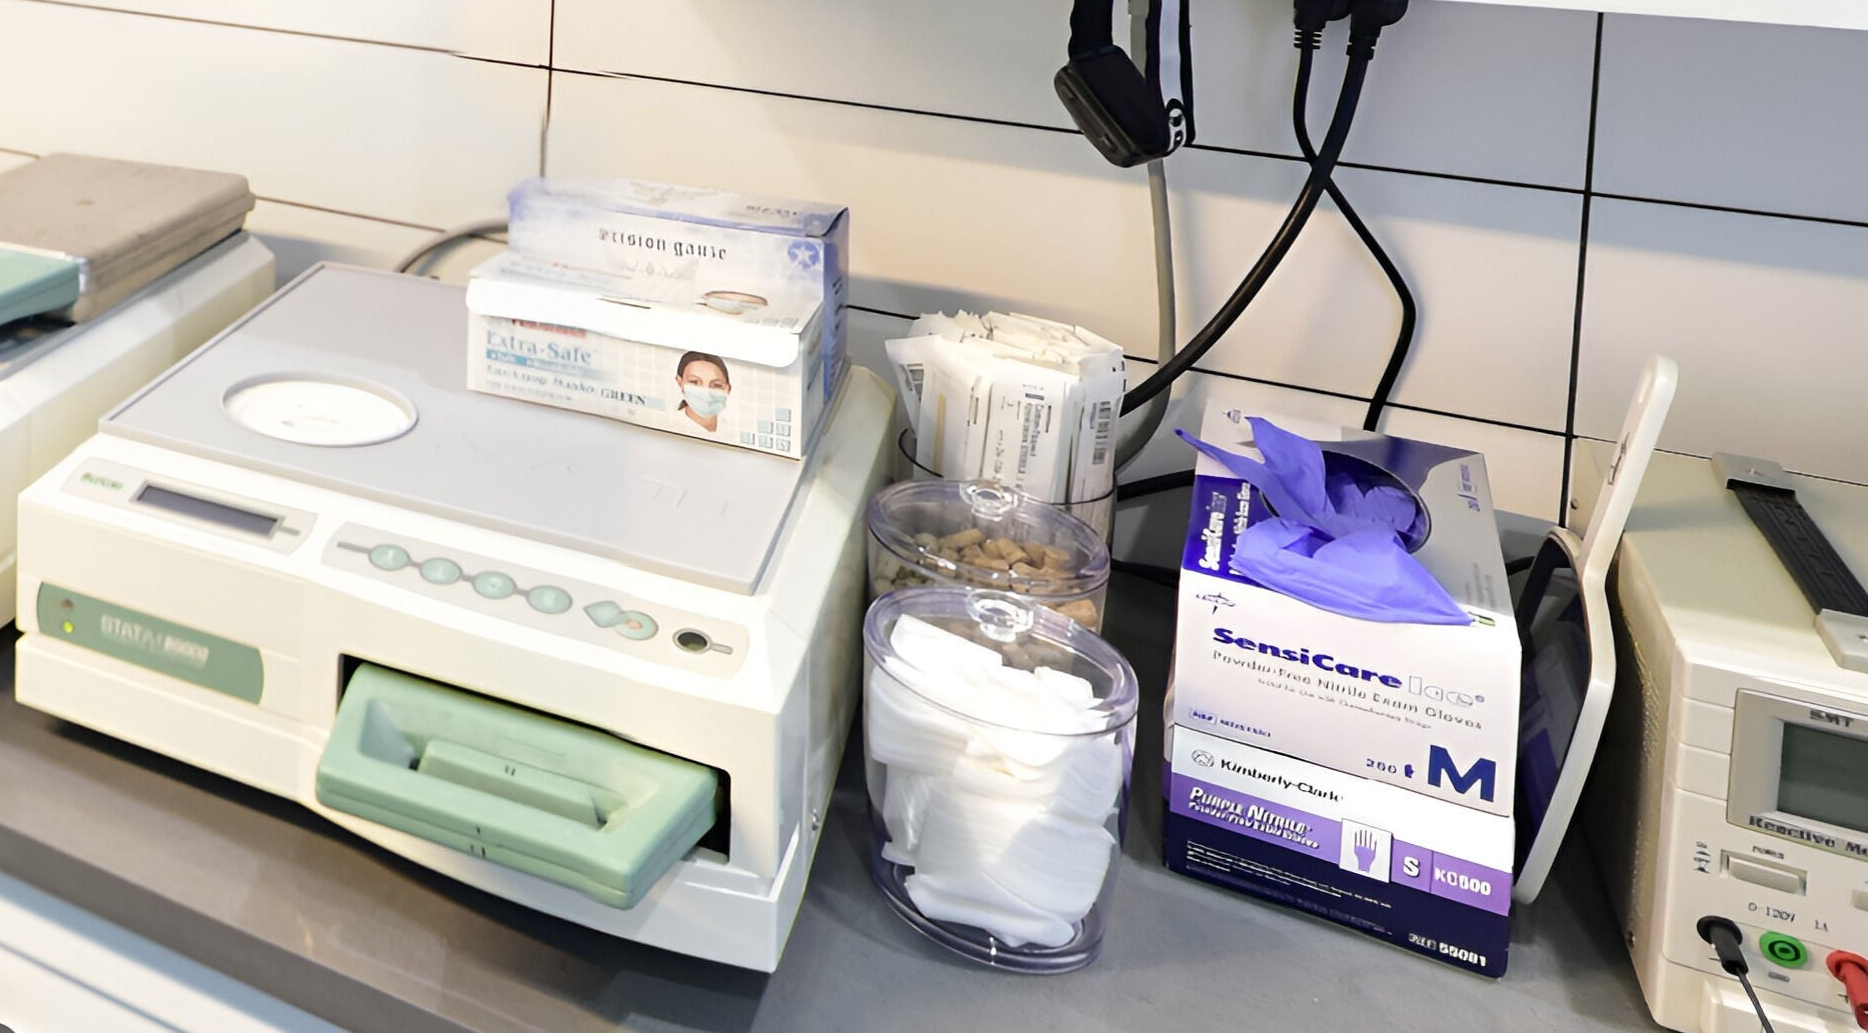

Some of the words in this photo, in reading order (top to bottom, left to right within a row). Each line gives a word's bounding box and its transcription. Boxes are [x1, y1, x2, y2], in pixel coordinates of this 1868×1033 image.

[1212, 627, 1403, 689] SensiCare
[1425, 706, 1483, 730] Gloves
[1427, 744, 1497, 803] M
[1402, 856, 1421, 878] S
